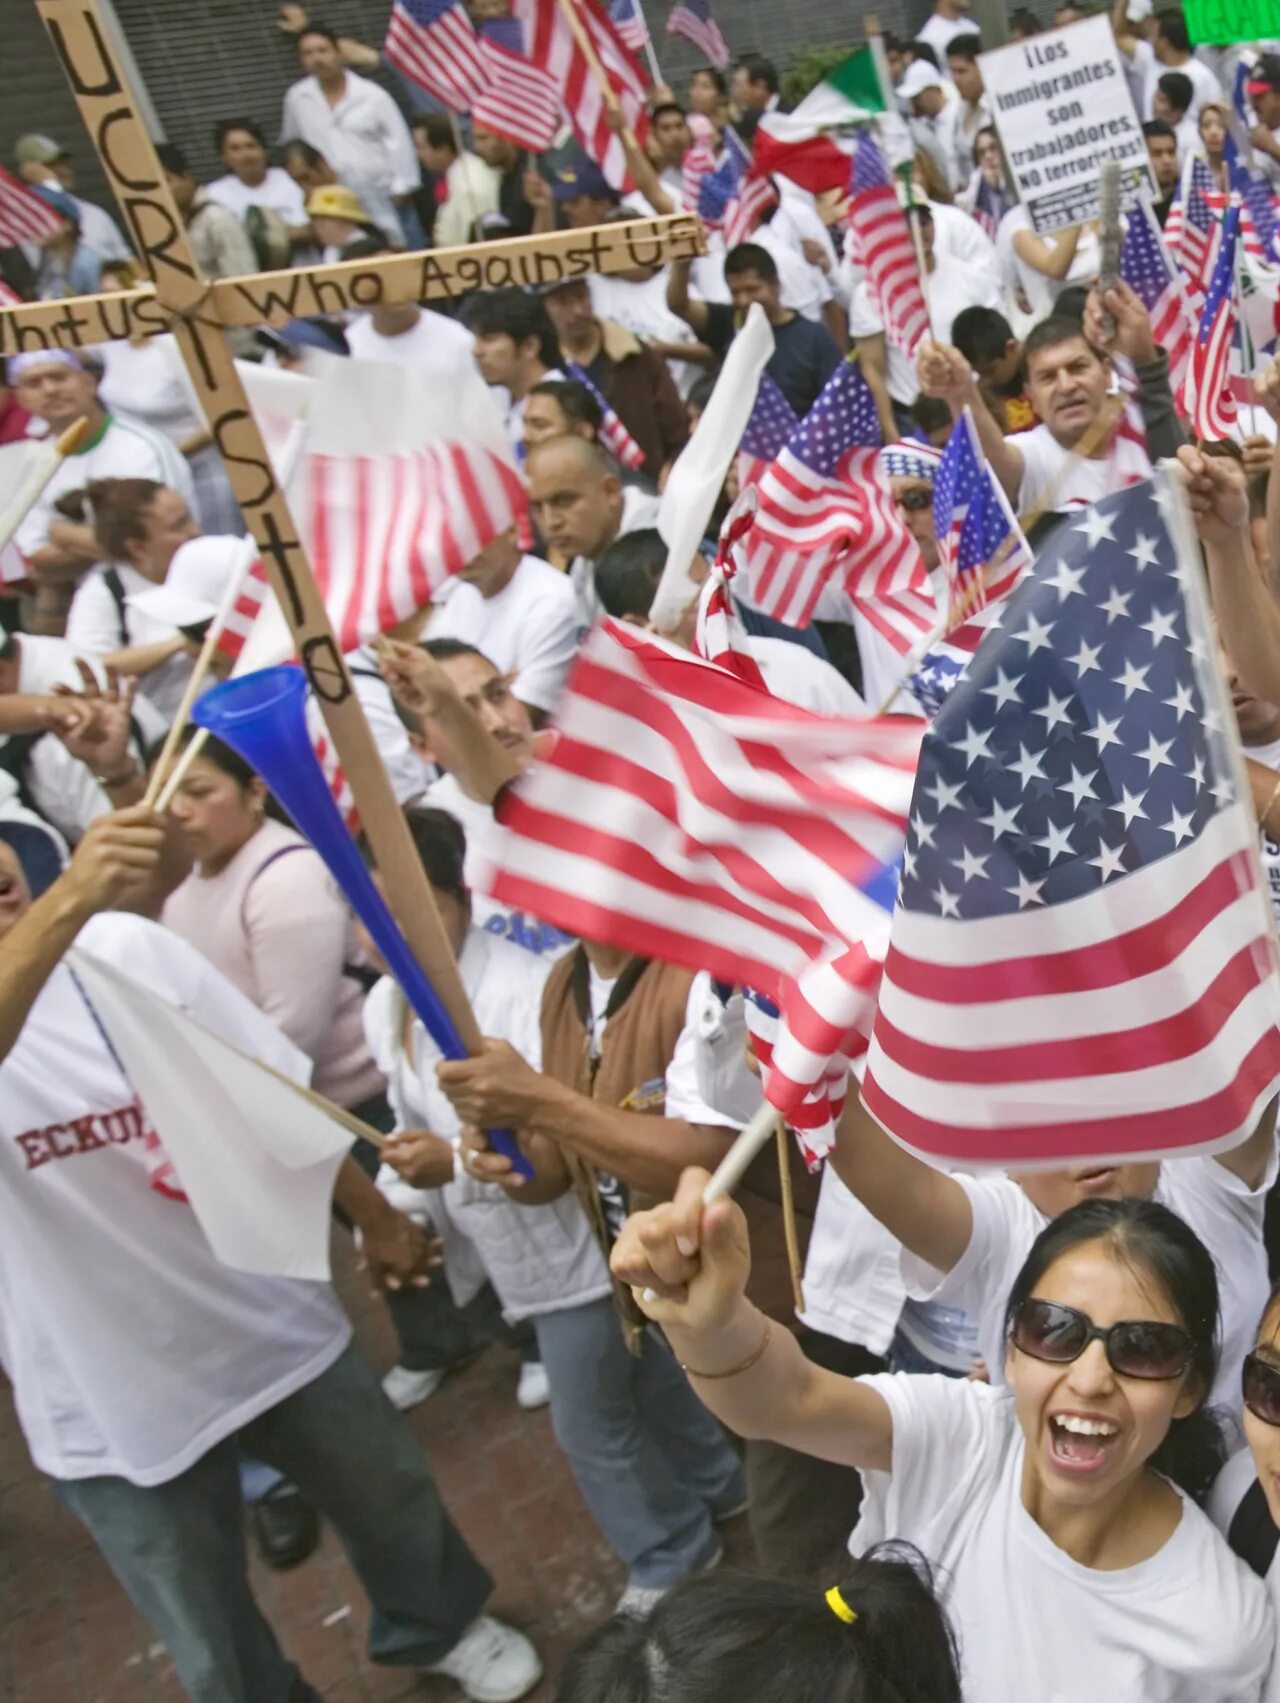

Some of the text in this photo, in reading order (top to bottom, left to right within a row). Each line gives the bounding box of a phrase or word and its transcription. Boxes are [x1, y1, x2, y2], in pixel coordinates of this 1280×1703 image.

[1046, 100, 1084, 125] son
[1018, 168, 1042, 190] NO
[235, 270, 384, 318] Who
[419, 231, 613, 300] Against
